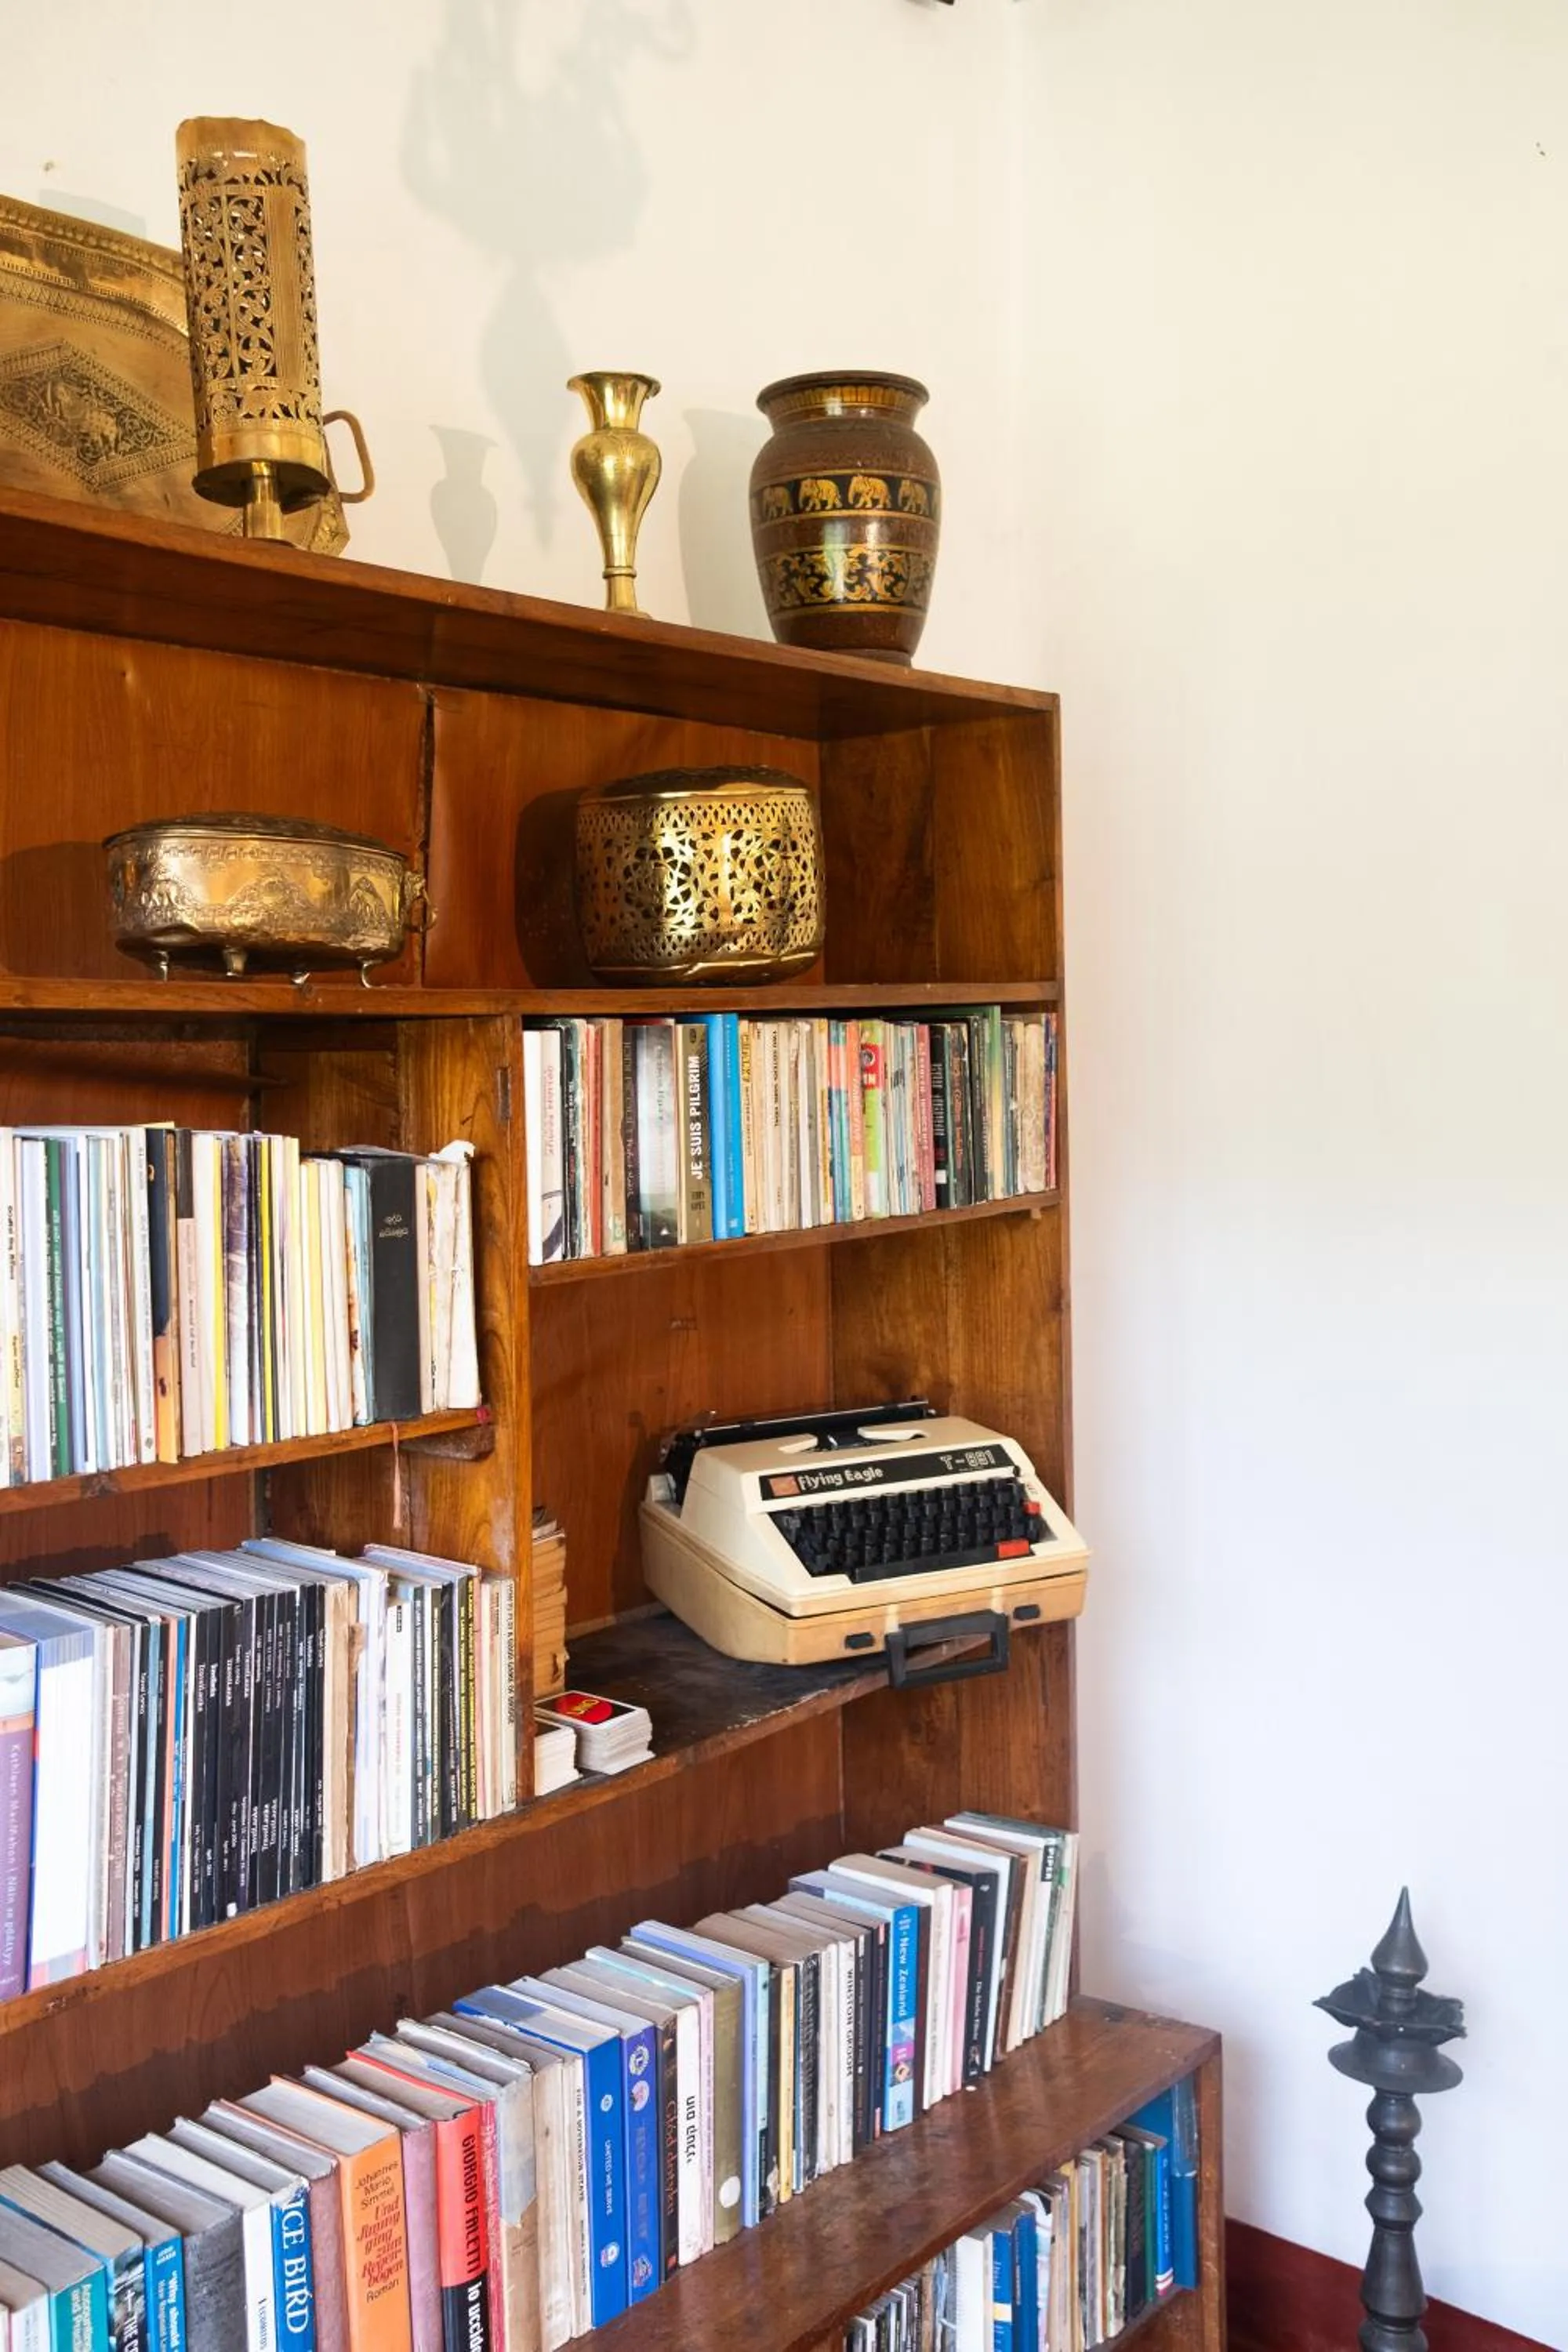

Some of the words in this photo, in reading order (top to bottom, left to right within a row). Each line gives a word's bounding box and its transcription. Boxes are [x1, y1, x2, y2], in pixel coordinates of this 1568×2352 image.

[688, 1056, 700, 1117] PILGRIM
[690, 1121, 702, 1156] SUIS
[691, 1160, 703, 1180] JE
[797, 1472, 843, 1490] Flying
[846, 1467, 883, 1483] Eagle
[9, 1743, 20, 1797] Kathleen
[7, 1799, 19, 1864] MacMahon
[1045, 1847, 1054, 1879] PIPER
[899, 1937, 909, 1963] New
[898, 1969, 909, 2016] Zealand
[686, 2095, 696, 2121] חום
[603, 2140, 613, 2172] UNITED
[684, 2125, 697, 2163] קטלני
[355, 2161, 398, 2189] Johannes
[461, 2134, 479, 2203] GIORGIO
[361, 2183, 395, 2210] Simmel
[365, 2176, 391, 2195] Mario
[375, 2195, 400, 2220] Und
[365, 2229, 393, 2256] ging
[377, 2236, 402, 2257] zum
[463, 2207, 481, 2274] FALETTI
[368, 2259, 404, 2288] bogen
[284, 2256, 309, 2334] BIRD
[366, 2278, 399, 2303] Roman
